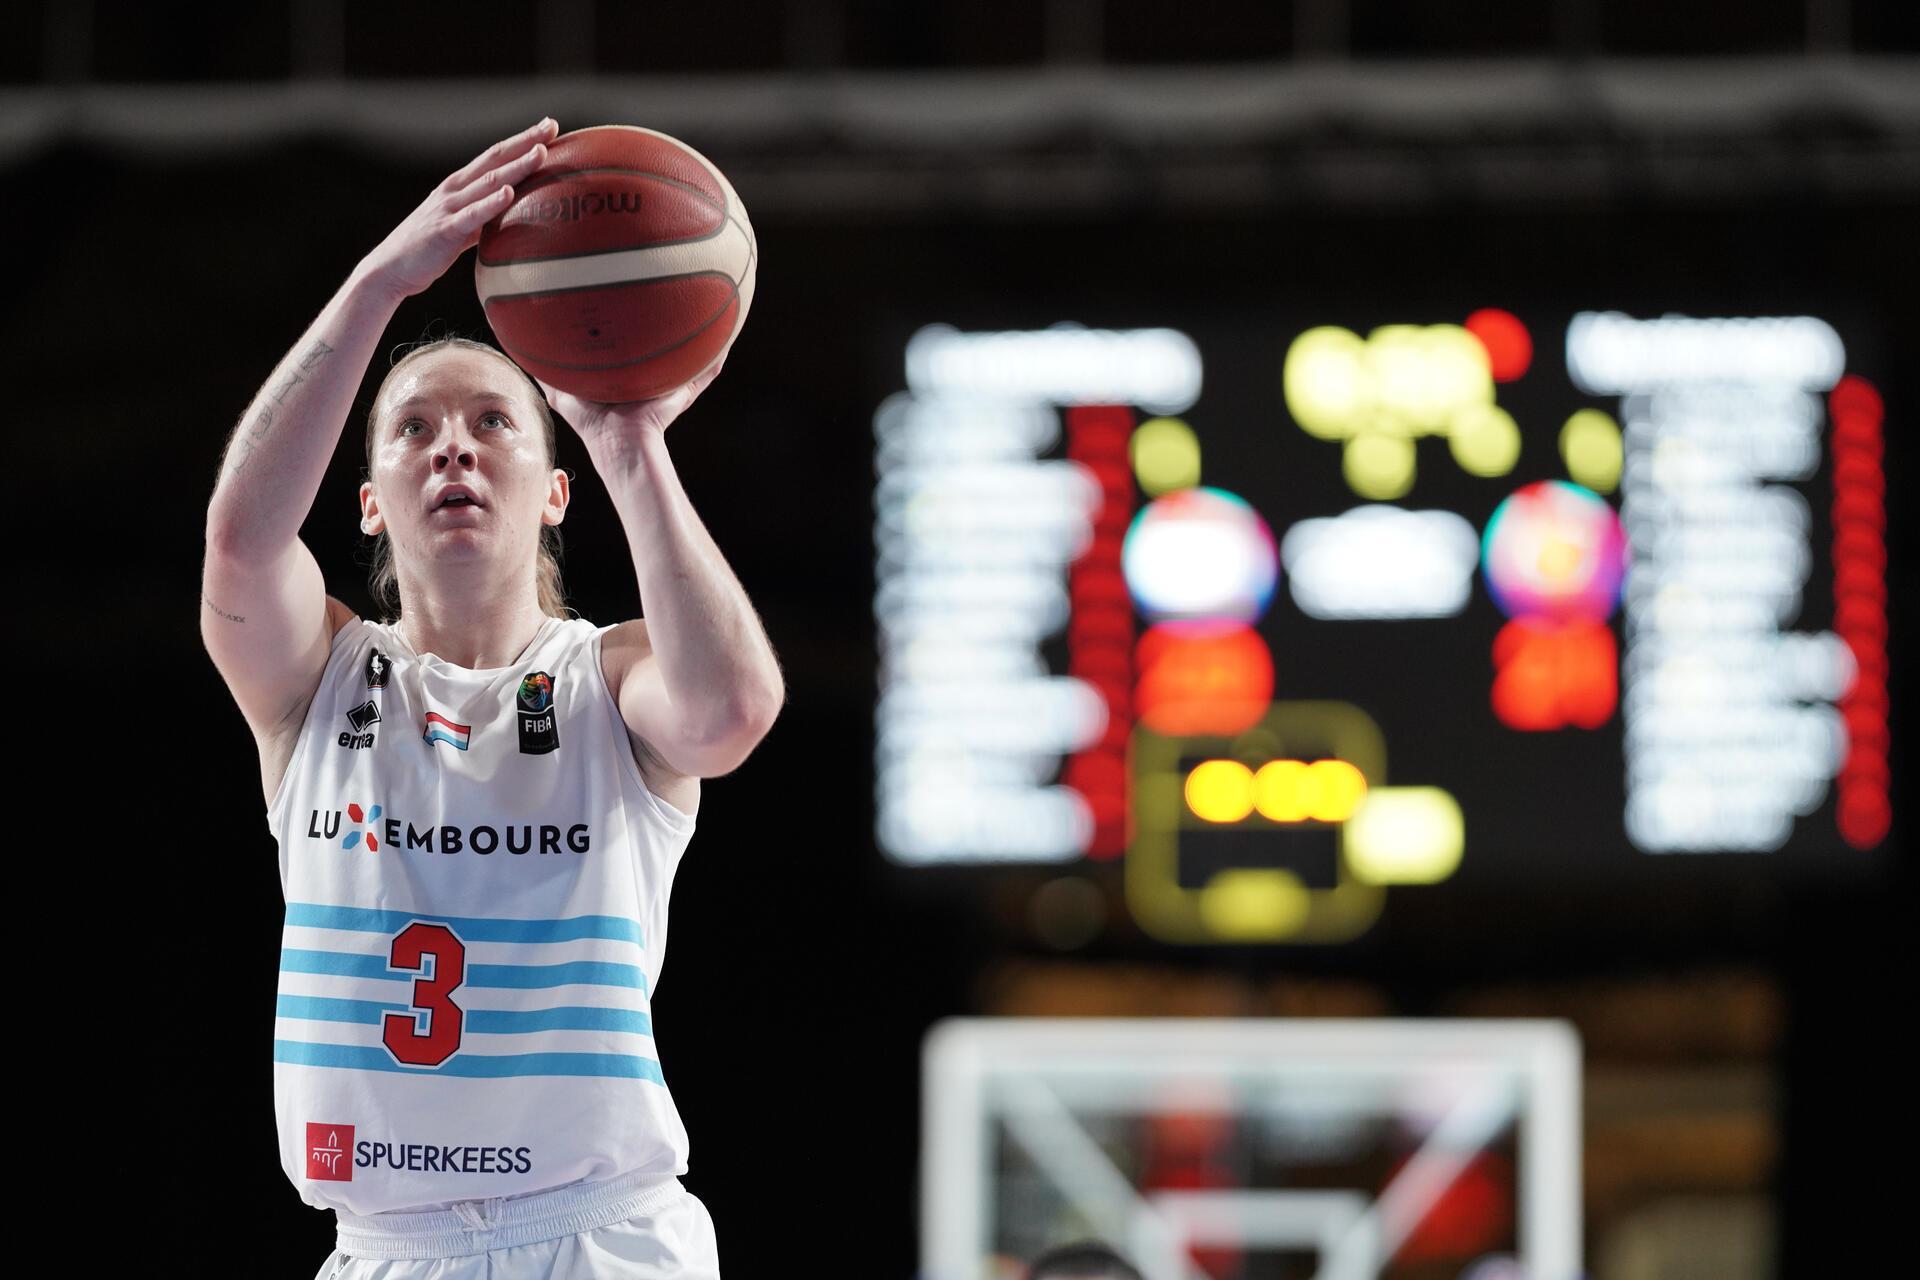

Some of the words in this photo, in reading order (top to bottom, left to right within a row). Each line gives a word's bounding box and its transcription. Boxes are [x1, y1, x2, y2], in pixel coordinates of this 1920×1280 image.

[520, 192, 641, 222] molten
[524, 715, 552, 733] FIBA
[307, 803, 590, 855] LUXEMBOURG
[382, 920, 466, 1068] 3
[355, 1141, 532, 1174] SPUERKEESS
